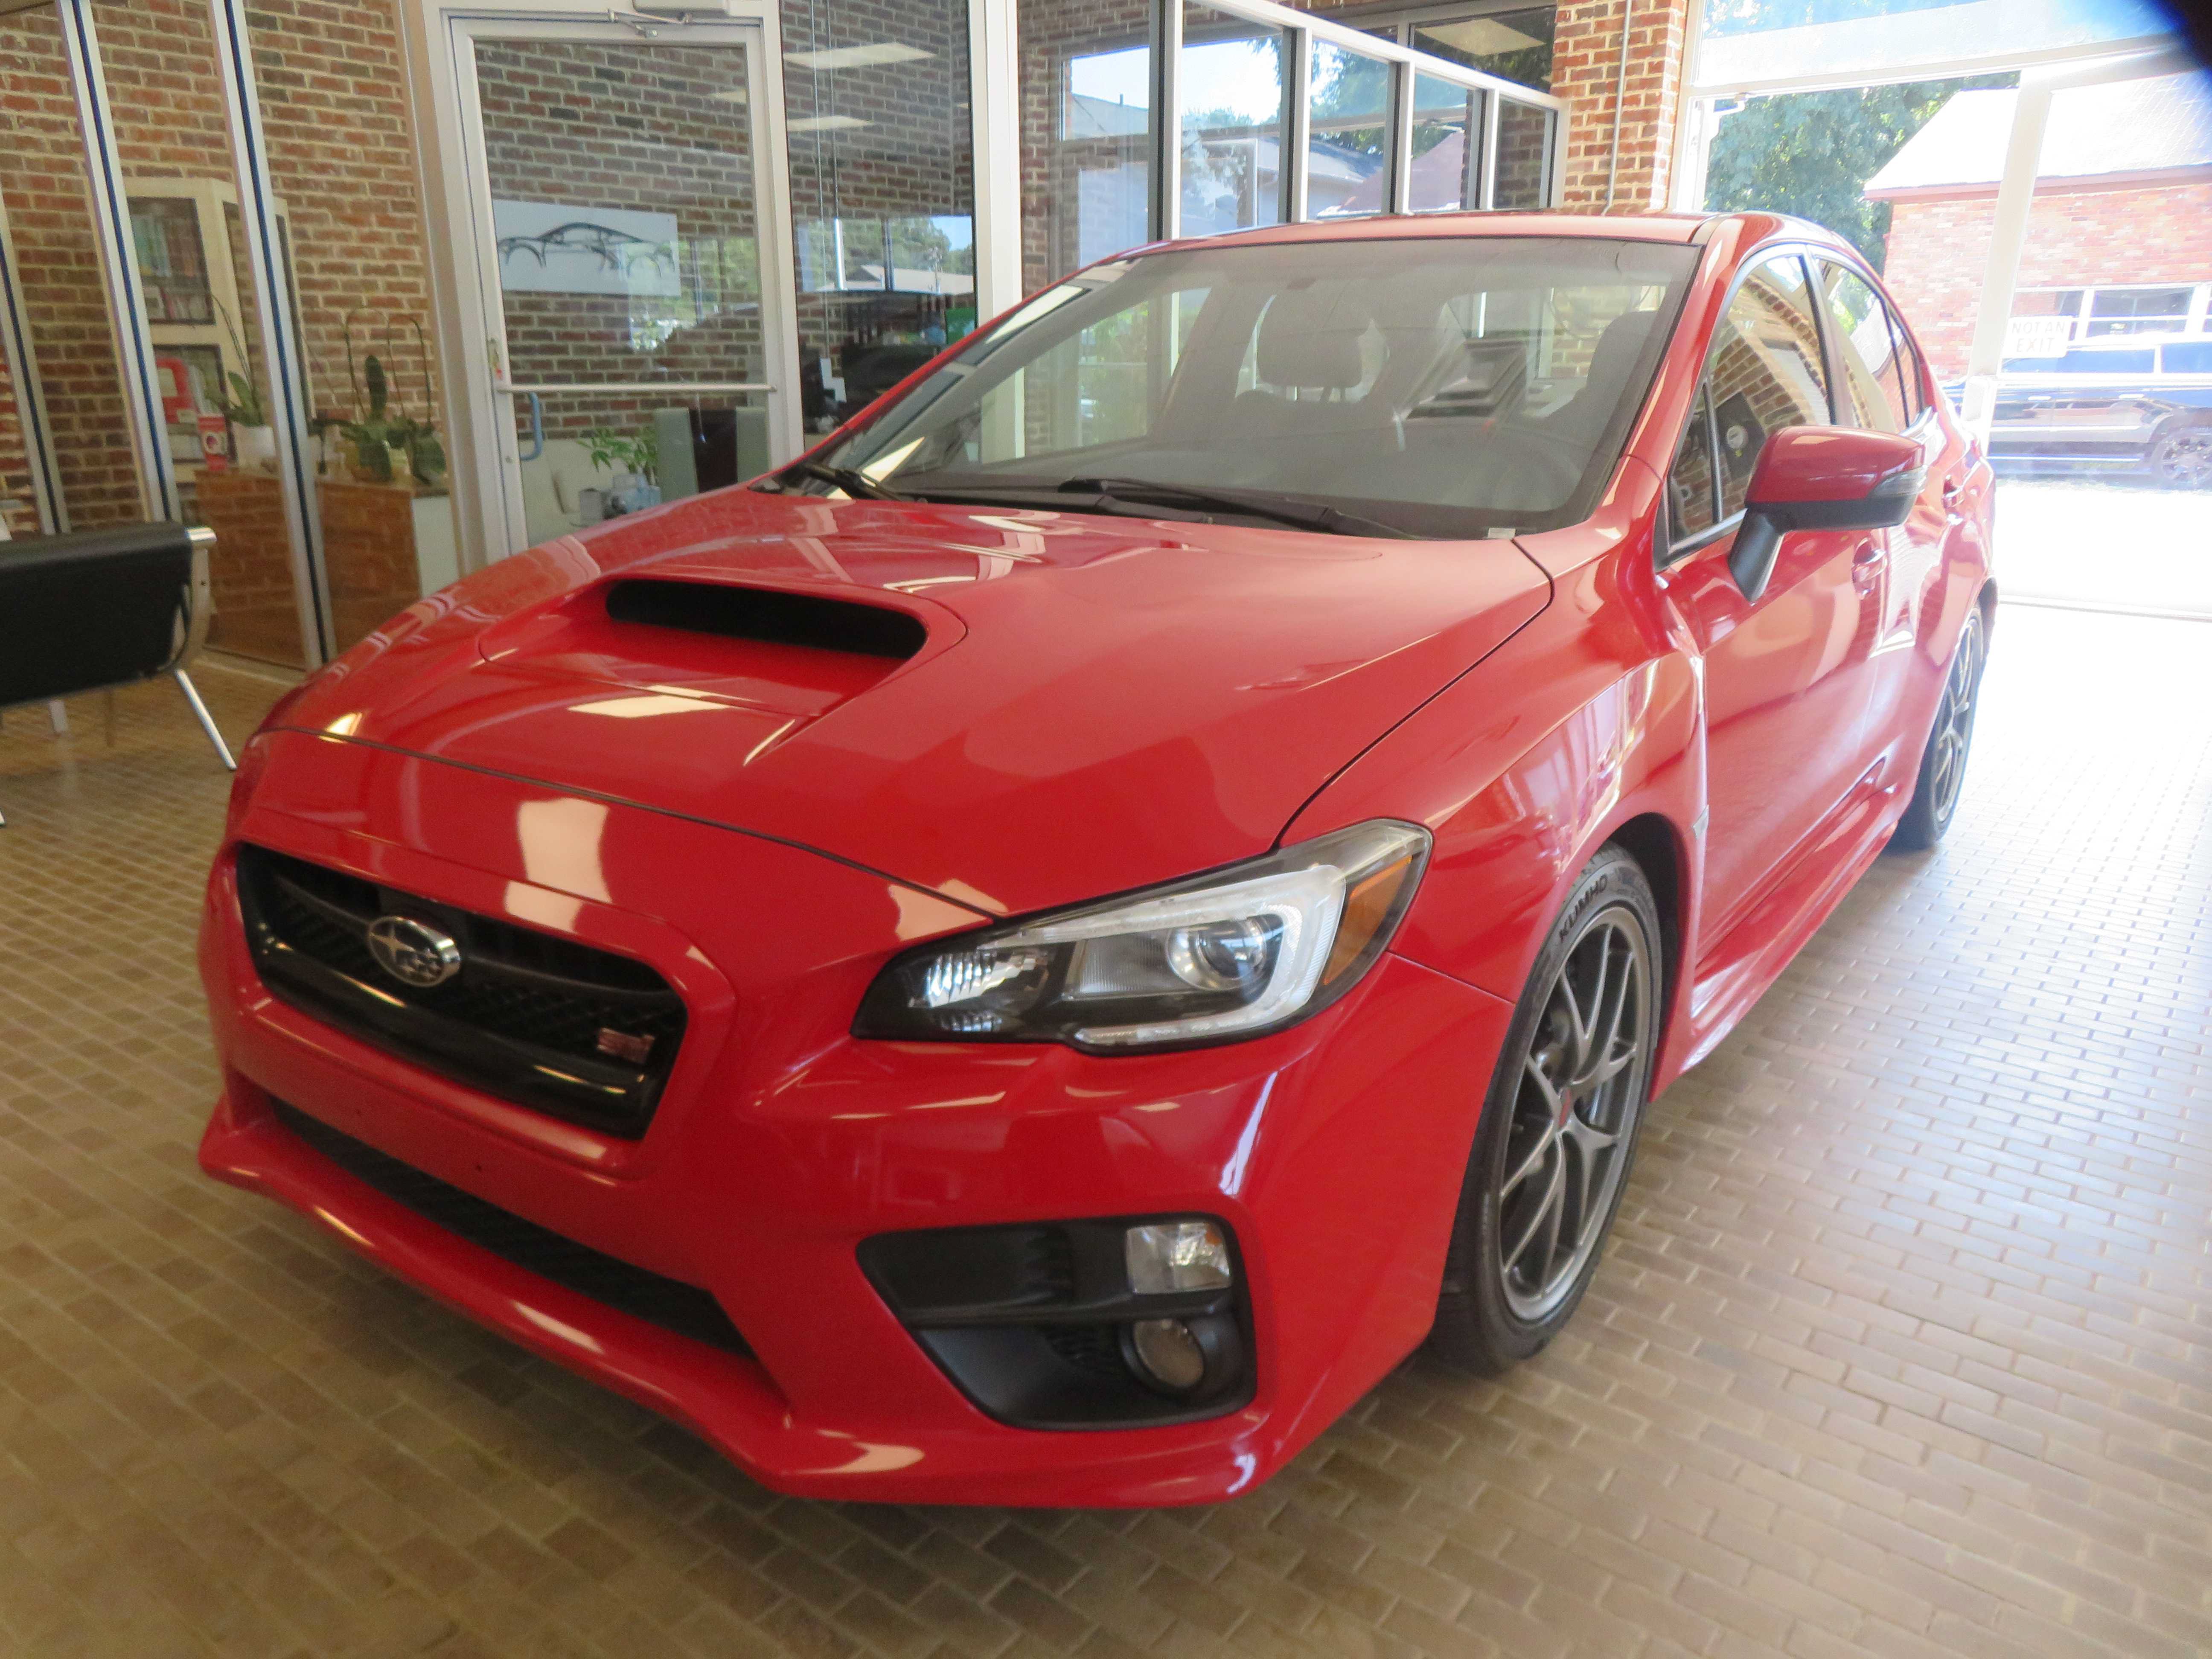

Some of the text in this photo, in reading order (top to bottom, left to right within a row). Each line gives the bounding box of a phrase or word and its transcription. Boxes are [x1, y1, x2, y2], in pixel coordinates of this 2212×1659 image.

[2012, 321, 2065, 334] NOT AN
[2017, 338, 2055, 352] EXIT
[1559, 874, 1608, 943] KUMHO
